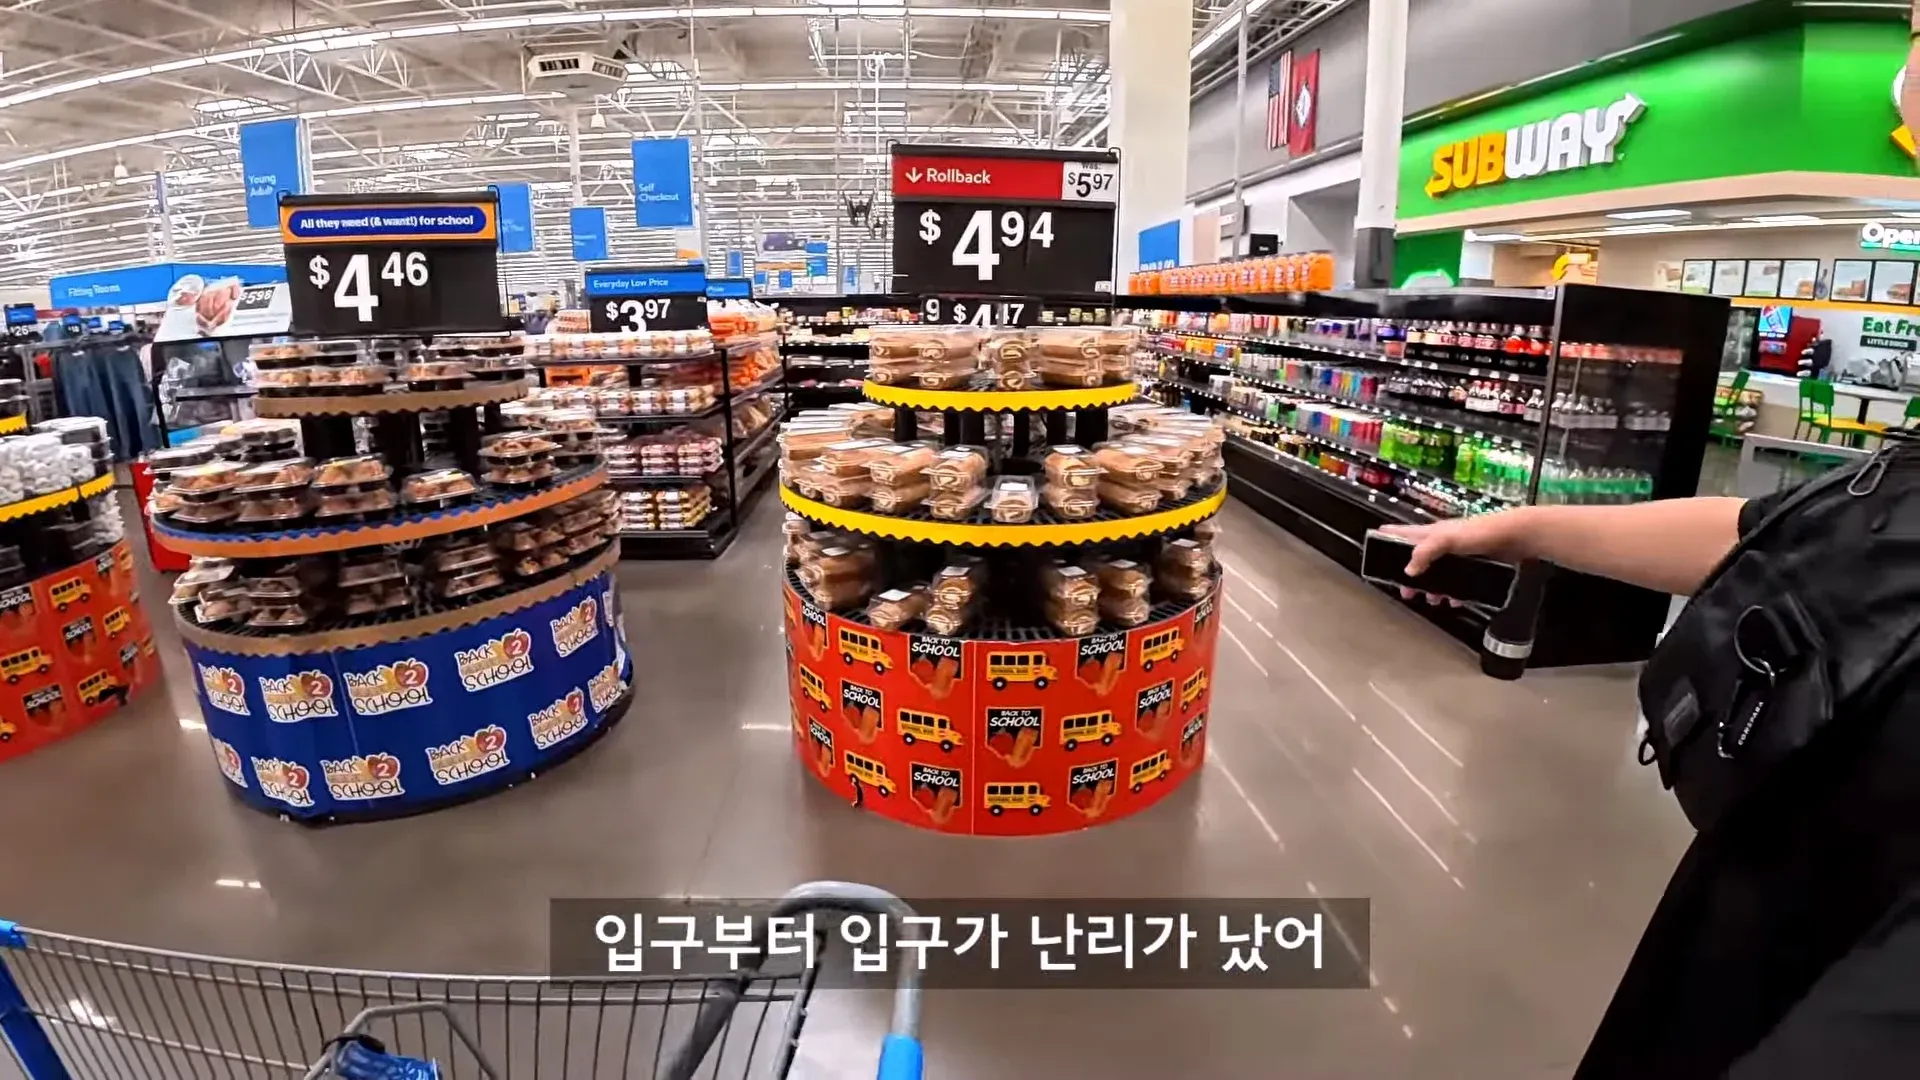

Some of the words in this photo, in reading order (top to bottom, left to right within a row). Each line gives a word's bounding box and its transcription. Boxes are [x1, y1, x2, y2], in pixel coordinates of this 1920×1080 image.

[1424, 93, 1647, 198] SUBWAY
[249, 173, 276, 186] Young
[926, 168, 991, 185] Rollback
[638, 183, 655, 193] Self
[638, 192, 680, 202] Checkout
[300, 218, 315, 229] All
[315, 218, 340, 230] they
[419, 215, 437, 226] for
[437, 214, 474, 226] school
[593, 278, 630, 290] Everyday
[630, 278, 648, 288] Low
[648, 277, 669, 287] Price
[1862, 316, 1892, 333] Eat
[802, 605, 826, 626] SCHOOL
[921, 636, 938, 645] BACK
[1080, 639, 1125, 656] SCHOOL
[457, 644, 493, 665] BACK
[510, 639, 523, 656] 2
[911, 642, 960, 657] SCHOOL
[347, 671, 384, 687] BACK
[405, 669, 420, 685] 2
[463, 656, 534, 690] SCHOOL
[261, 679, 292, 693] BACK
[310, 680, 322, 696] 2
[850, 684, 864, 694] BACK
[357, 688, 432, 714] SCHOOL
[843, 688, 881, 709] SCHOOL
[1139, 688, 1171, 709] SCHOOL
[531, 707, 560, 727] BACK
[990, 716, 1040, 727] SCHOOL
[429, 741, 466, 761] BACK
[485, 734, 498, 750] 2
[324, 761, 357, 775] BACK
[376, 762, 390, 778] 2
[436, 752, 509, 784] SCHOOL
[922, 767, 939, 775] BACK
[1072, 767, 1115, 784] SCHOOL
[1083, 766, 1098, 774] BACK
[289, 771, 300, 787] 2
[913, 771, 959, 787] SCHOOL
[331, 780, 404, 799] SCHOOL
